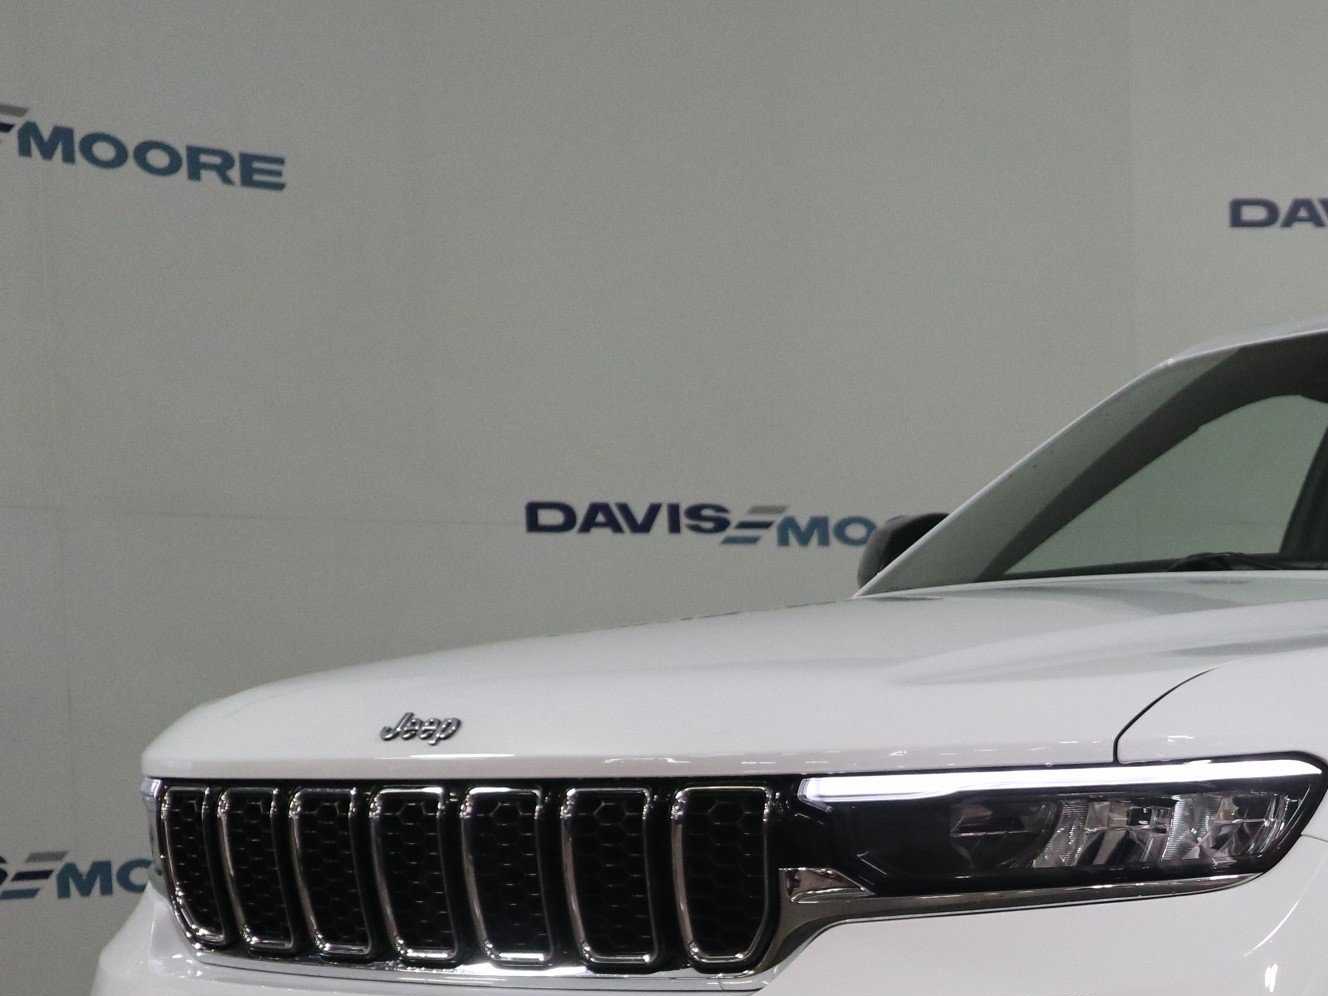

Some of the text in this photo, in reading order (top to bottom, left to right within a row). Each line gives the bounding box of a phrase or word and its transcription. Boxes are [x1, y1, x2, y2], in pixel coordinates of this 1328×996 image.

[17, 120, 286, 191] MOORE
[525, 501, 732, 534] DAVIS
[380, 711, 462, 746] Jeep
